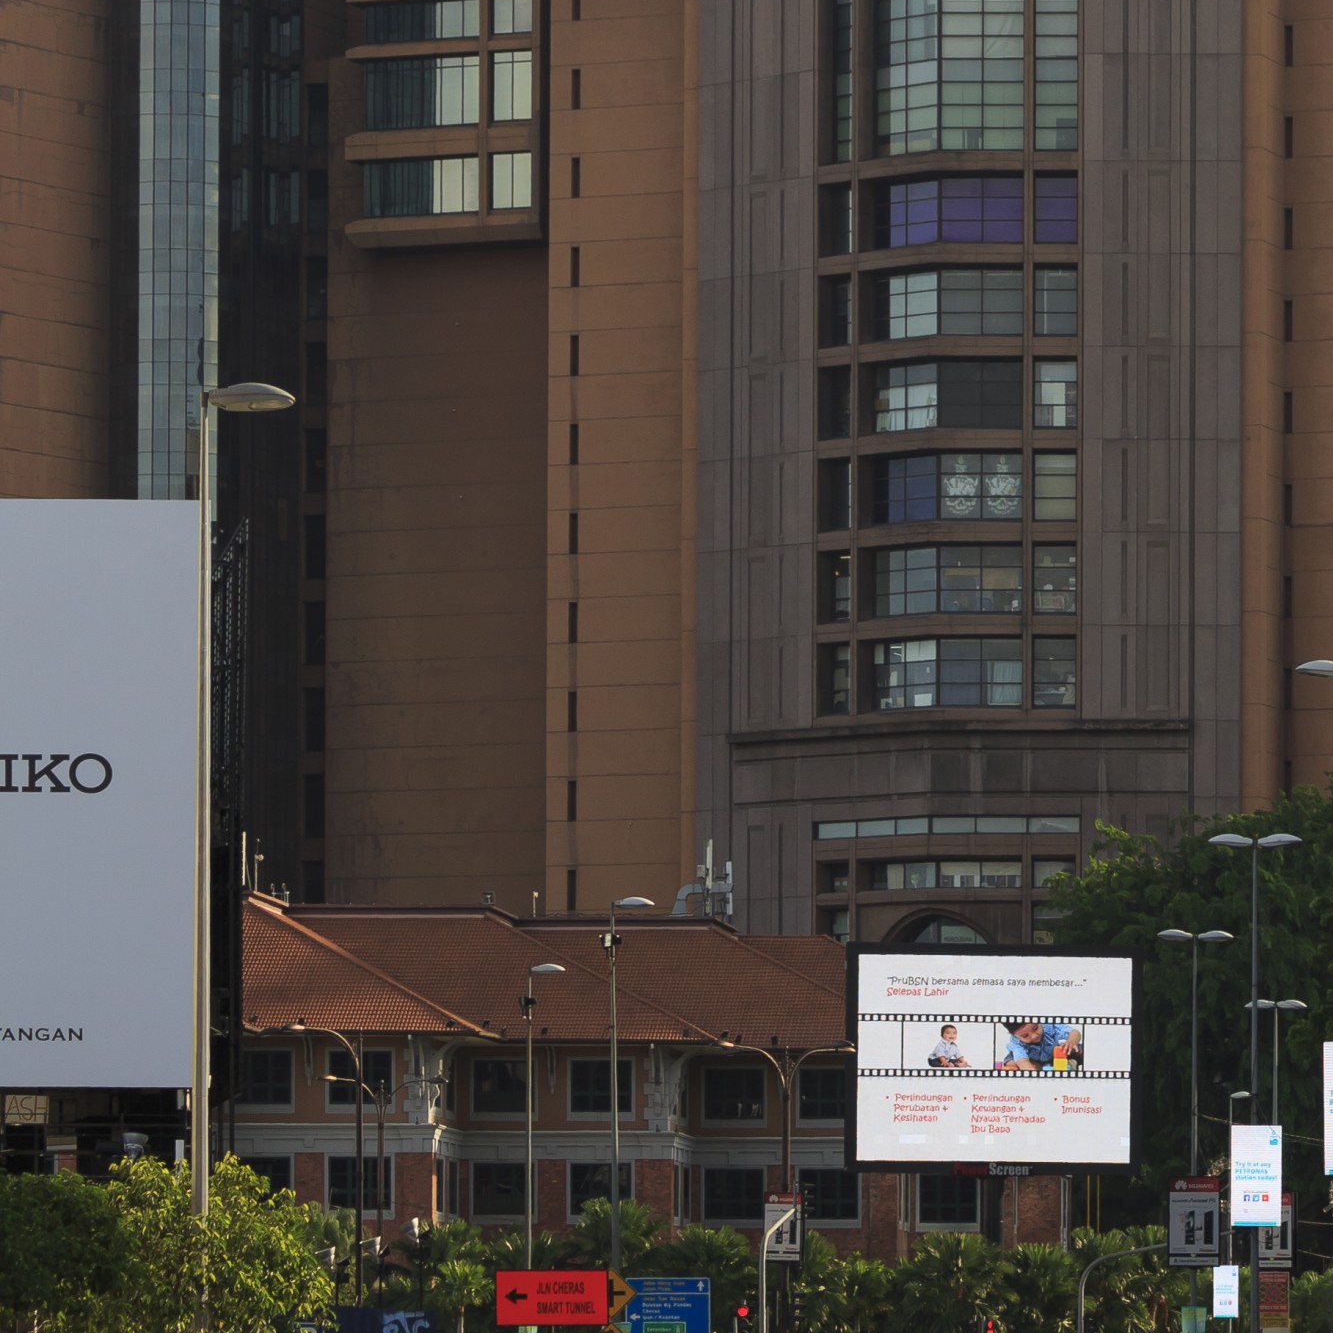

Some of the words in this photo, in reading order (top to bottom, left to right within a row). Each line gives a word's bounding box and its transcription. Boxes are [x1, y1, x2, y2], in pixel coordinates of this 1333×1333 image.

[931, 977, 970, 986] bersama
[972, 978, 1005, 986] semasa
[1007, 979, 1026, 987] saya
[886, 988, 922, 997] Selepas
[924, 988, 949, 996] Lahir
[0, 1027, 84, 1041] ANGAN
[895, 1093, 953, 1102] Perlindungan
[973, 1094, 1031, 1103] Perlindungan
[1062, 1095, 1091, 1103] Bonus
[893, 1104, 940, 1112] Perubatan
[971, 1105, 1017, 1113] Kewangan
[1061, 1105, 1102, 1114] Imunisasi
[893, 1114, 938, 1122] Kesihatan
[971, 1115, 1001, 1124] Nyawa
[1002, 1115, 1046, 1124] Terhadap
[971, 1125, 986, 1133] Ibu
[988, 1125, 1011, 1133] Bapa
[536, 1282, 551, 1294] JLN
[552, 1282, 585, 1294] CHERAS
[537, 1301, 563, 1314] SMART
[565, 1301, 596, 1314] TUNNEL
